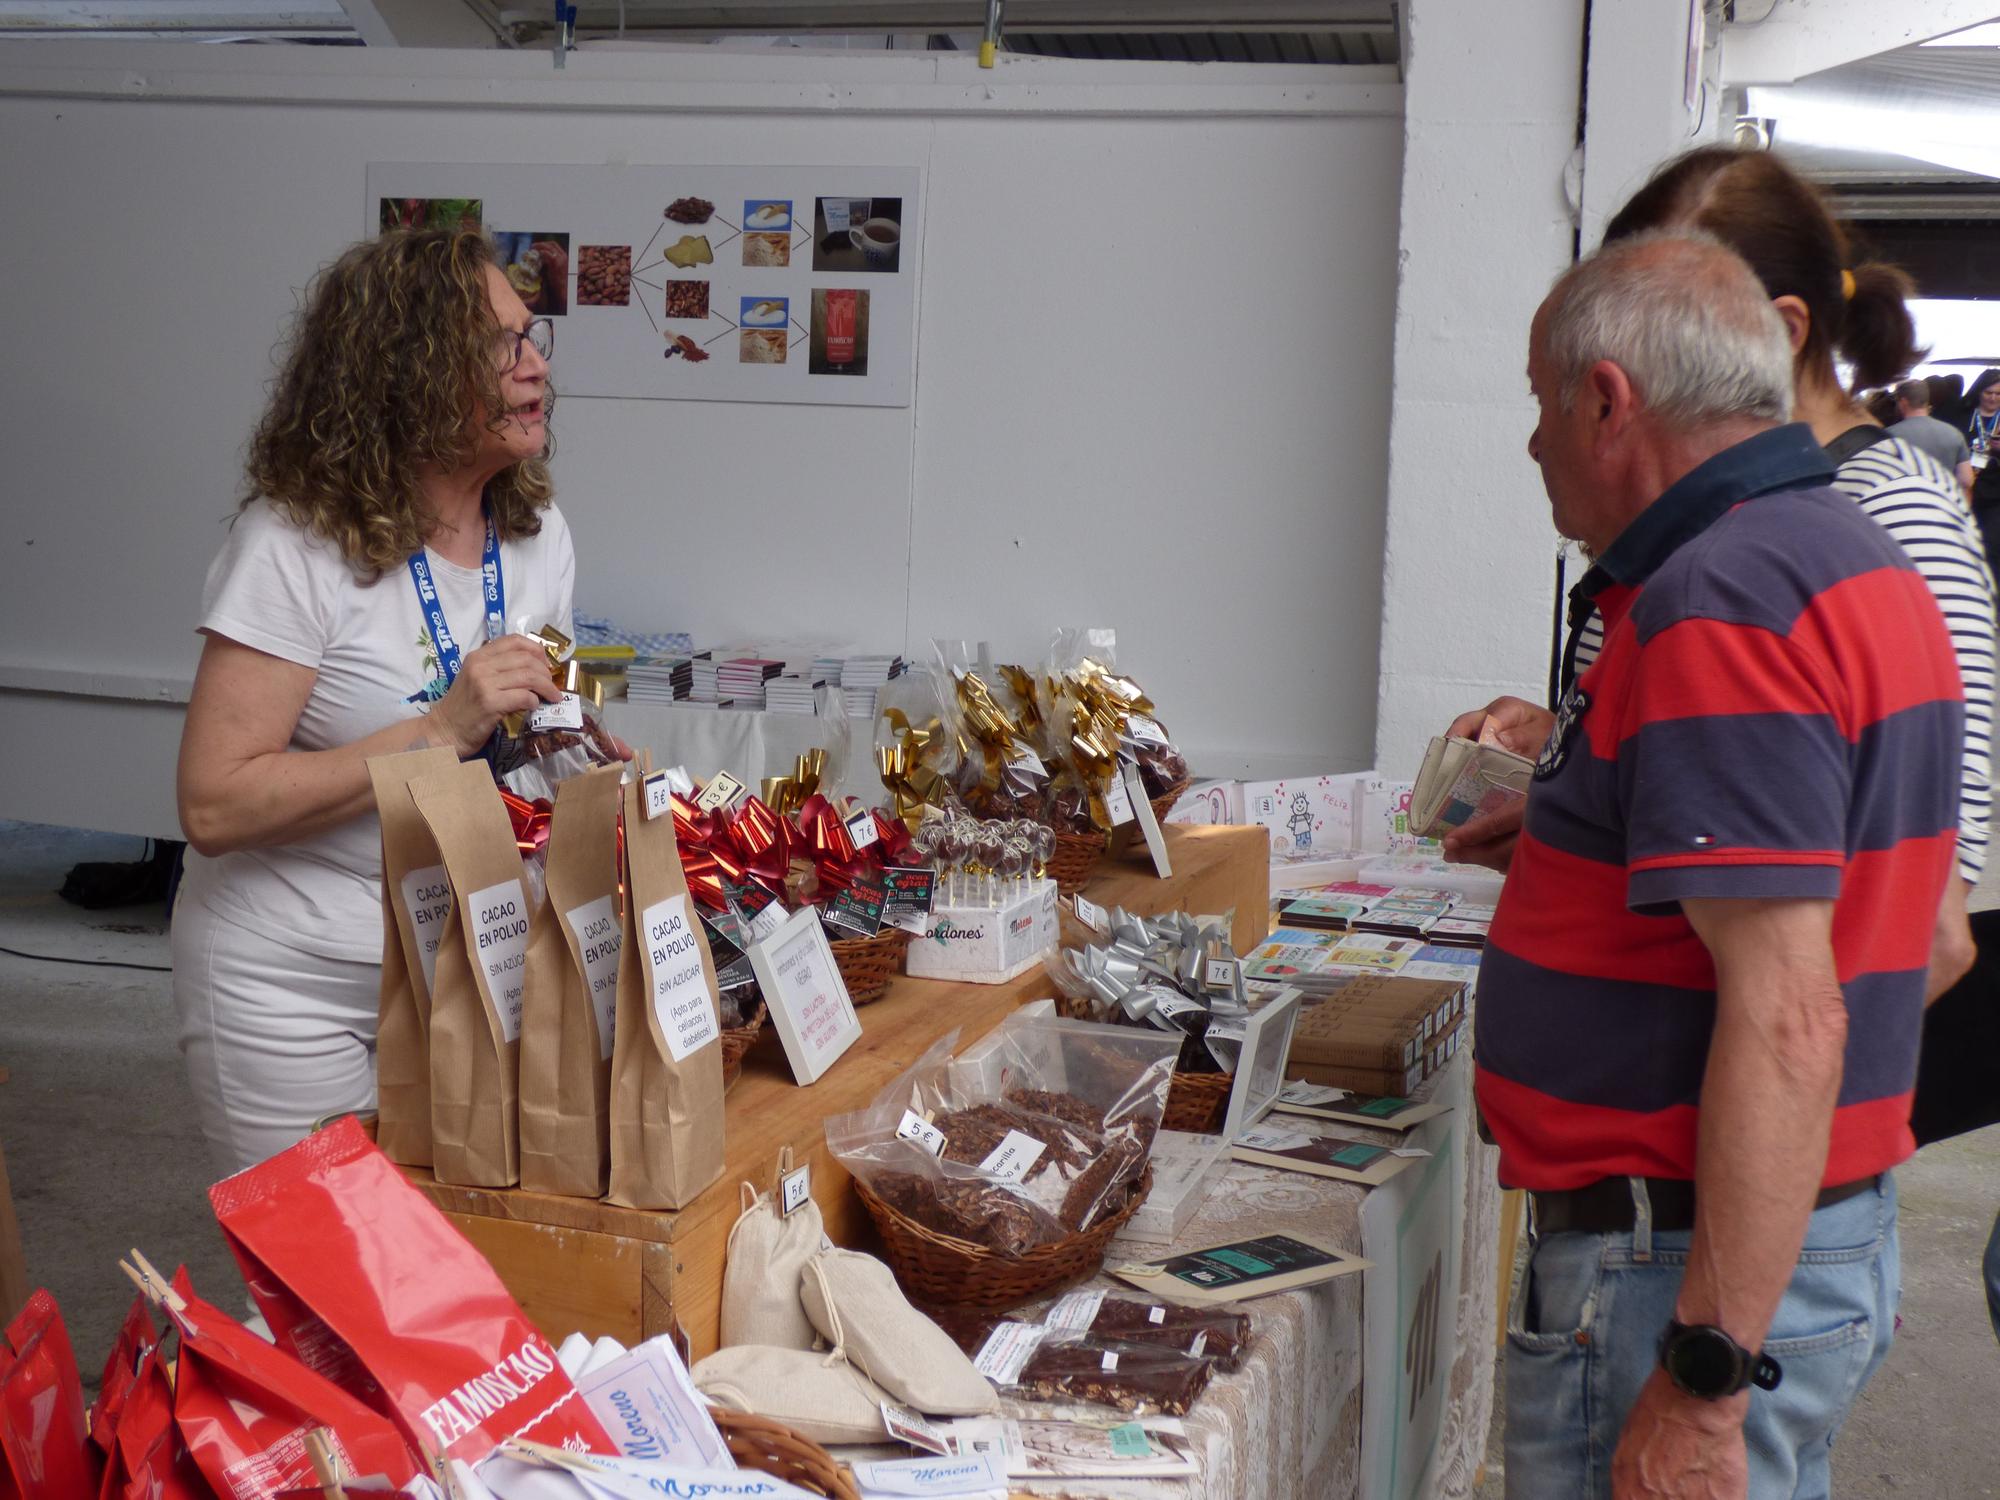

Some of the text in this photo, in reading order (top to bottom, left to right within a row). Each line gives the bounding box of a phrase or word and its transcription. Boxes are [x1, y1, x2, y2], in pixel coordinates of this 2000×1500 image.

[705, 781, 729, 806] 13 €
[416, 883, 450, 902] CACA
[415, 909, 433, 925] EN
[481, 901, 516, 925] CACAO
[479, 919, 528, 949] EN POLVO
[584, 917, 611, 940] CACAO
[652, 915, 682, 941] CACAO
[926, 924, 984, 940] ordones
[585, 949, 599, 964] EN
[652, 933, 695, 966] EN POLVO
[489, 952, 525, 977] SIN AZÚCA
[1214, 967, 1228, 979] 7 €
[593, 978, 607, 993] SIN
[659, 981, 672, 996] SIN
[672, 964, 701, 989] AZÚCAR
[670, 996, 703, 1021] (Apto para
[911, 1122, 934, 1143] 5 €
[992, 1147, 1016, 1173] carilla
[420, 1343, 554, 1449] FAMOSCAO
[609, 1390, 661, 1460] Moreno
[912, 1464, 978, 1482] Moreno
